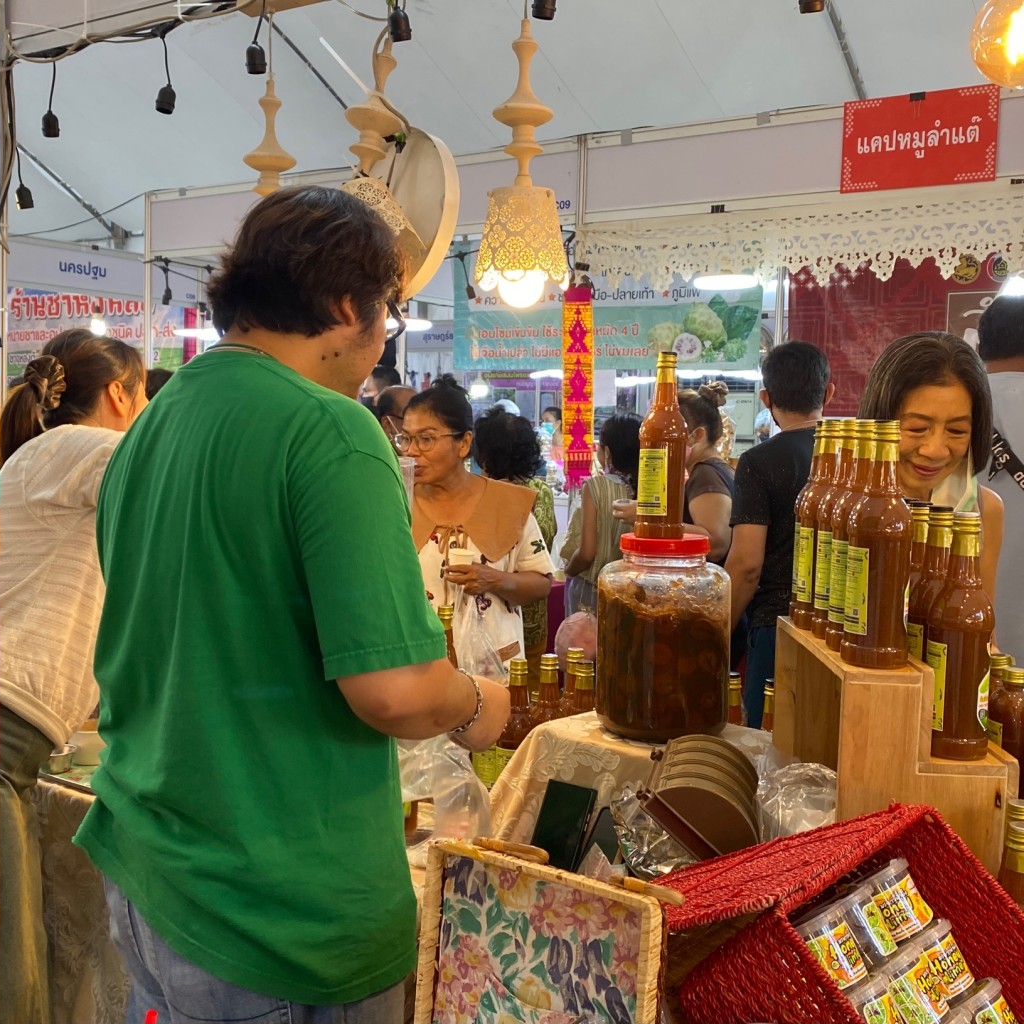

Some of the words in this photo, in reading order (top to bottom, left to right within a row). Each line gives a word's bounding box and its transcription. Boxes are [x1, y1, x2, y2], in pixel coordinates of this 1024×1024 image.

[856, 115, 983, 158] แคปหมูลำแต๊
[58, 261, 107, 280] นครปฐม
[621, 325, 629, 336] 4
